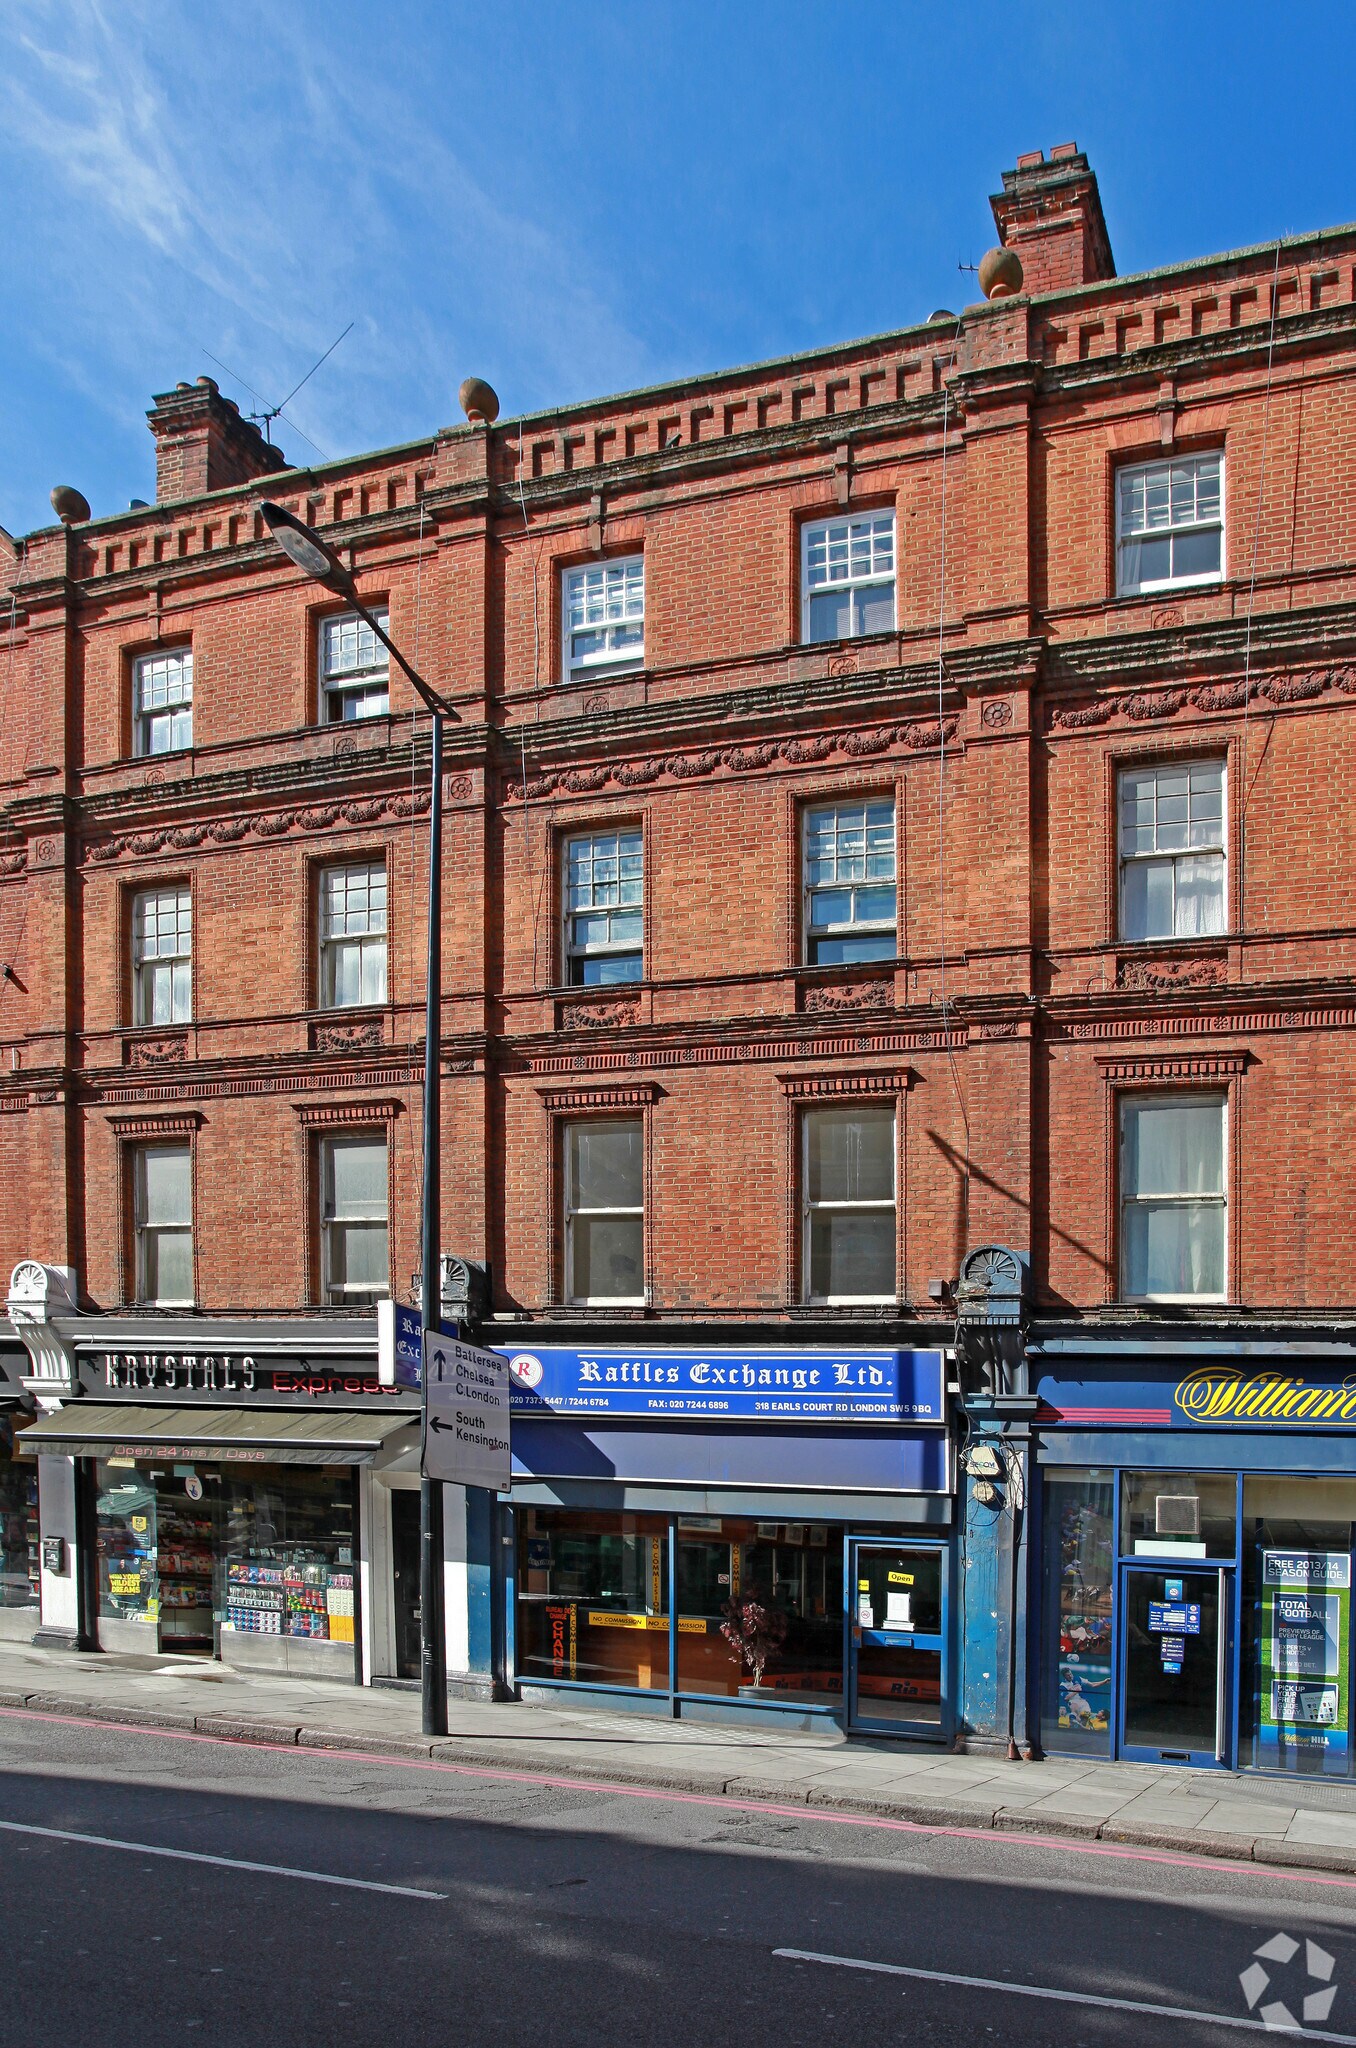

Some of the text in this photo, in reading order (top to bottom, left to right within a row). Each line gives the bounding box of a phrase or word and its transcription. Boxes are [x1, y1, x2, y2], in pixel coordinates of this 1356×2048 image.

[455, 1345, 502, 1372] Battersea
[105, 1353, 256, 1389] KRYSTALS
[455, 1364, 495, 1387] Chelsea
[578, 1360, 893, 1389] Raffles Exchange Ltd.
[455, 1382, 500, 1406] C.London
[1174, 1366, 1356, 1423] William
[510, 1396, 524, 1404] 020
[525, 1396, 543, 1405] 7373
[544, 1396, 563, 1405] 5447
[569, 1397, 589, 1406] 7244
[590, 1398, 609, 1407] 6784
[648, 1399, 729, 1410] FAX: 020 7244 6896
[755, 1401, 770, 1410] 318
[771, 1402, 801, 1411] EARLS
[802, 1402, 833, 1412] COURT
[835, 1403, 848, 1412] RD
[850, 1403, 888, 1413] LONDON
[911, 1405, 932, 1414] 9BQ
[455, 1411, 486, 1430] South
[456, 1427, 509, 1451] Kensington
[114, 1445, 153, 1457] Open
[156, 1445, 178, 1457] 24
[181, 1446, 207, 1457] hrs
[226, 1448, 265, 1462] Days
[1268, 1560, 1339, 1570] FREE 2013/14
[652, 1536, 660, 1613] NO COMMISSION
[891, 1573, 911, 1583] Open
[1268, 1568, 1346, 1580] SEASON GUIDE.
[111, 1579, 141, 1587] WILDEST
[111, 1586, 141, 1594] DREAMS
[570, 1604, 577, 1617] NO
[1279, 1600, 1311, 1610] TOTAL
[549, 1612, 567, 1620] CHANGE
[1279, 1609, 1332, 1620] FOOTBALL
[604, 1616, 642, 1625] COMMISSION
[1278, 1627, 1311, 1635] PREVIEWS
[552, 1620, 564, 1677] CHANGE
[890, 1680, 919, 1696] Ria
[1277, 1684, 1295, 1692] PICK
[1277, 1690, 1297, 1698] YOUR
[1277, 1696, 1296, 1704] FREE
[1311, 1735, 1330, 1745] HILL
